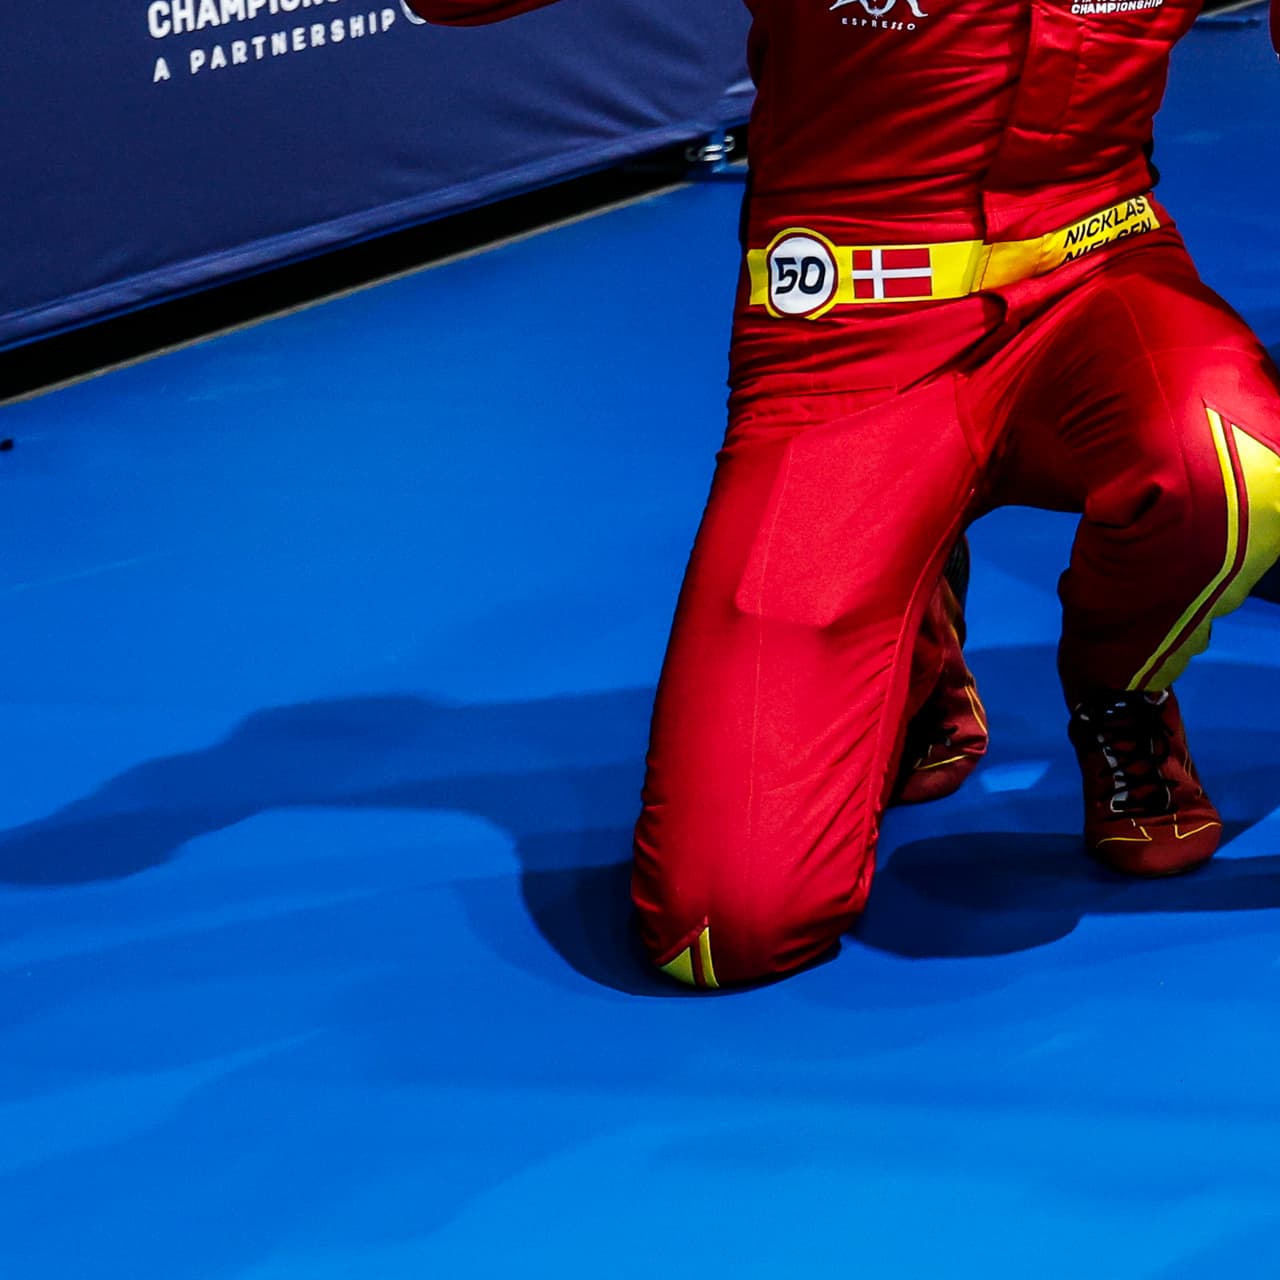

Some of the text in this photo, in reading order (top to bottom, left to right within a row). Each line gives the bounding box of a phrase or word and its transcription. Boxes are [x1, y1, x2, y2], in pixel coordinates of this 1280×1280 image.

[153, 8, 396, 83] A PARTNERSHIP
[841, 17, 916, 31] ESPRESSO
[1063, 197, 1146, 249] NICKLAS
[774, 256, 826, 295] 50
